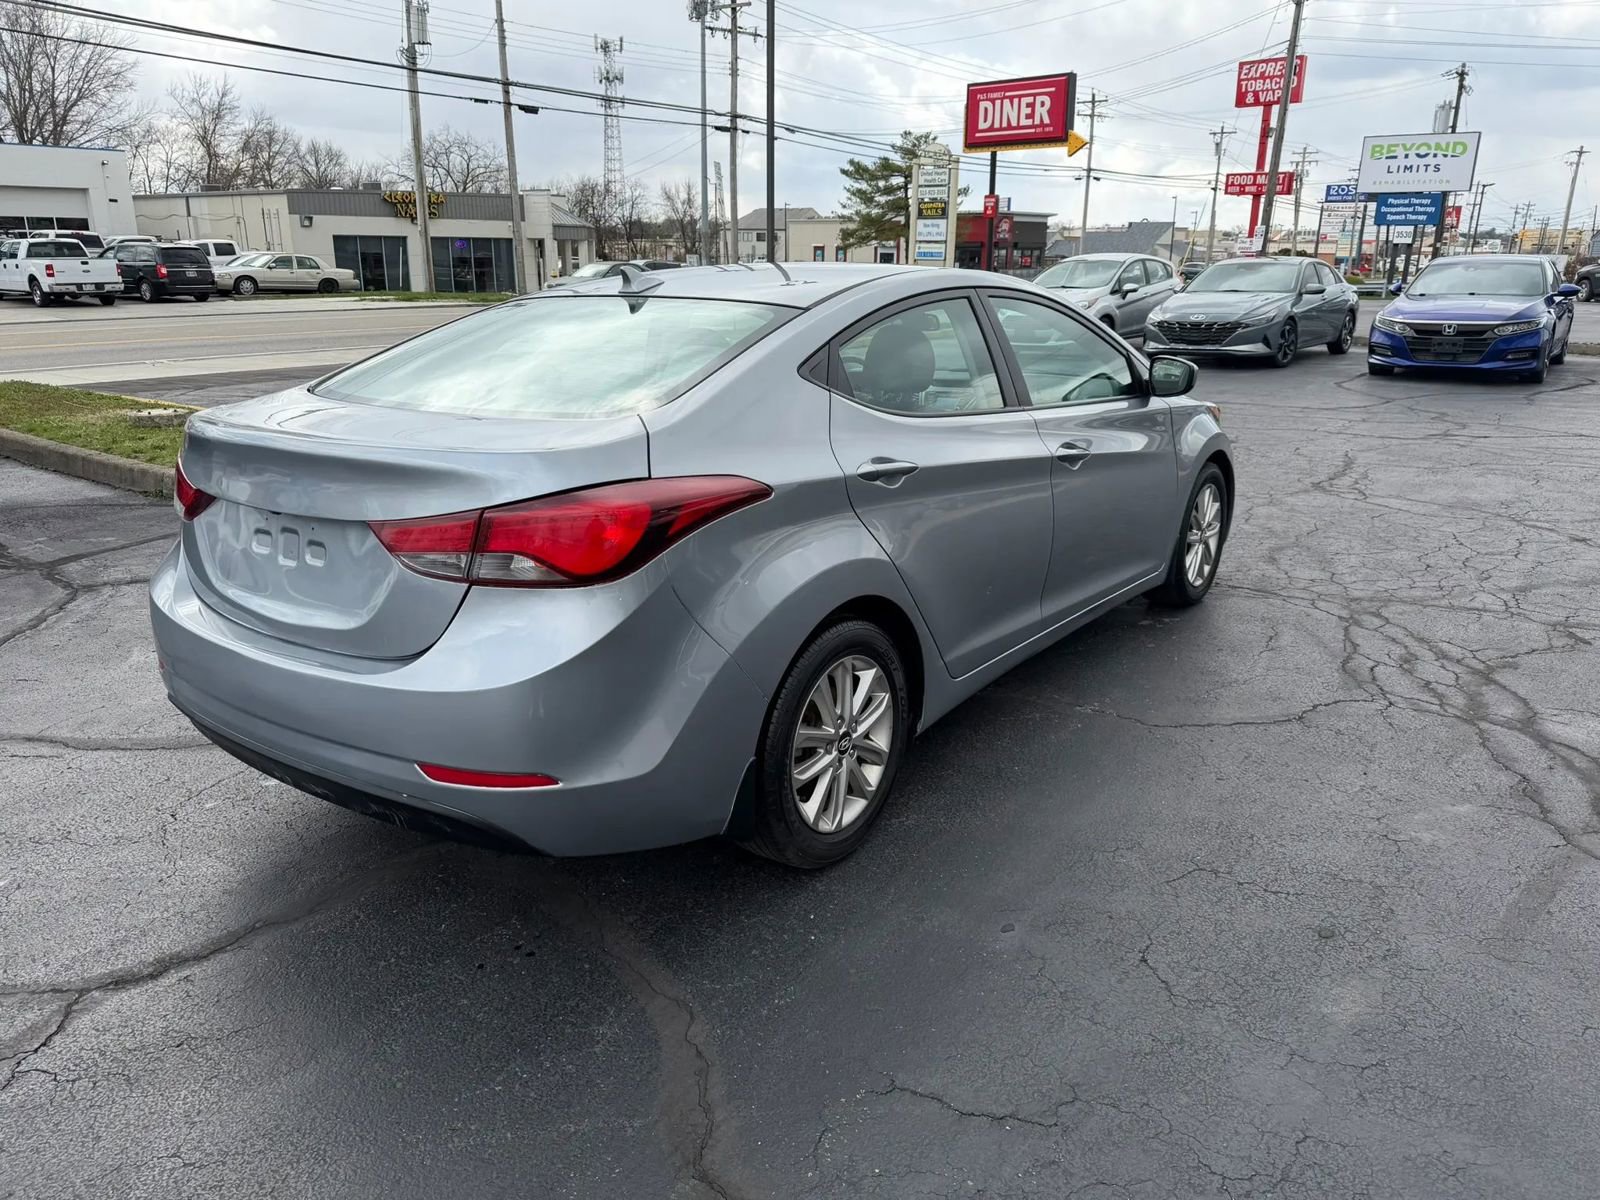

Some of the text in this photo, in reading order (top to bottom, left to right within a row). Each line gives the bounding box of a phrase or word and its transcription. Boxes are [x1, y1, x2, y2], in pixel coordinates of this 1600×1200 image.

[1240, 59, 1300, 79] EXPRE
[1246, 90, 1282, 104] & VAP
[978, 96, 1051, 130] DINER
[1370, 141, 1468, 160] BEYOND
[1387, 164, 1441, 174] LIMITS
[1228, 174, 1284, 185] FOOD MT
[1330, 185, 1356, 195] ROS
[384, 191, 446, 203] CLEOPRA
[396, 204, 439, 217] NAS
